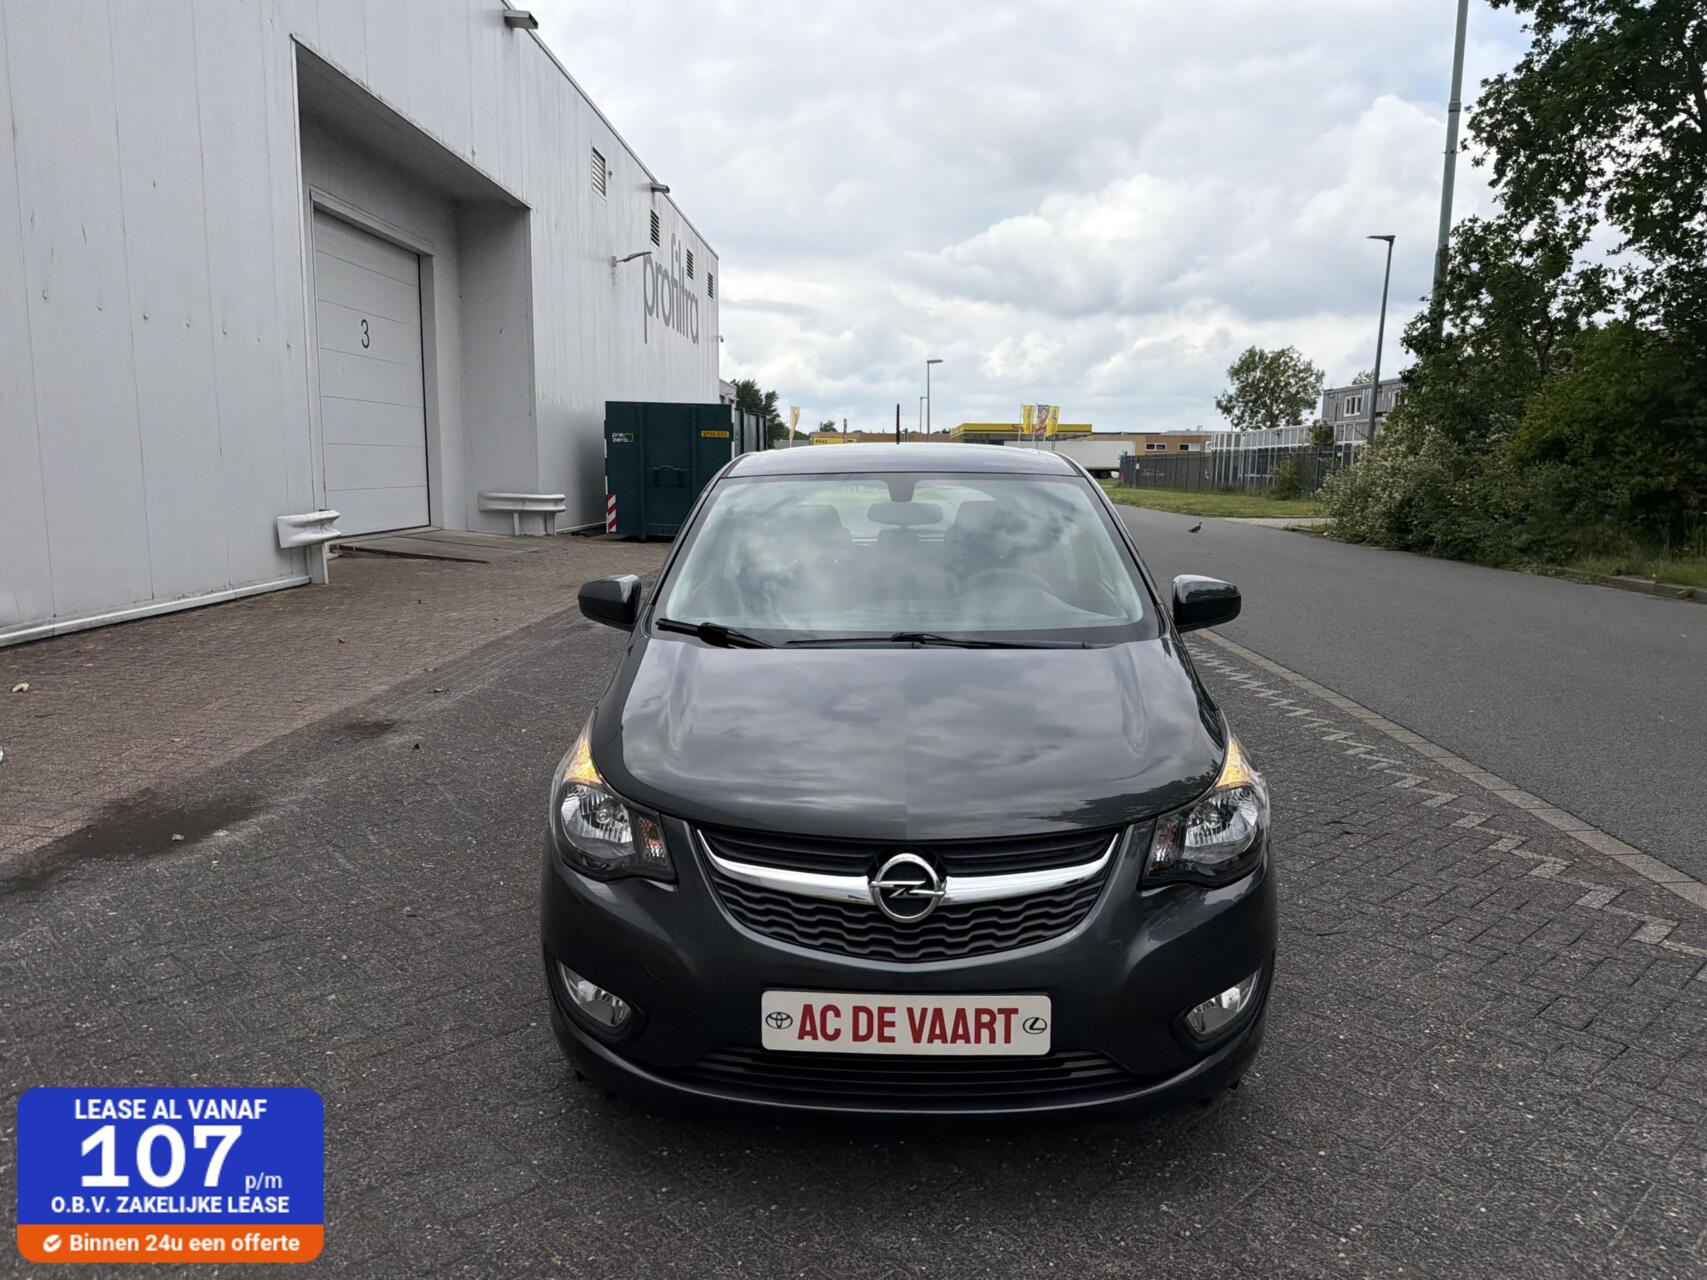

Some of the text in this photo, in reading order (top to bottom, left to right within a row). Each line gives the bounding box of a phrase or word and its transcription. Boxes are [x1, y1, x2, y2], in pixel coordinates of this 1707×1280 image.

[643, 233, 699, 345] profiltra
[360, 319, 370, 349] 3
[797, 1003, 1019, 1044] AC DE VAART
